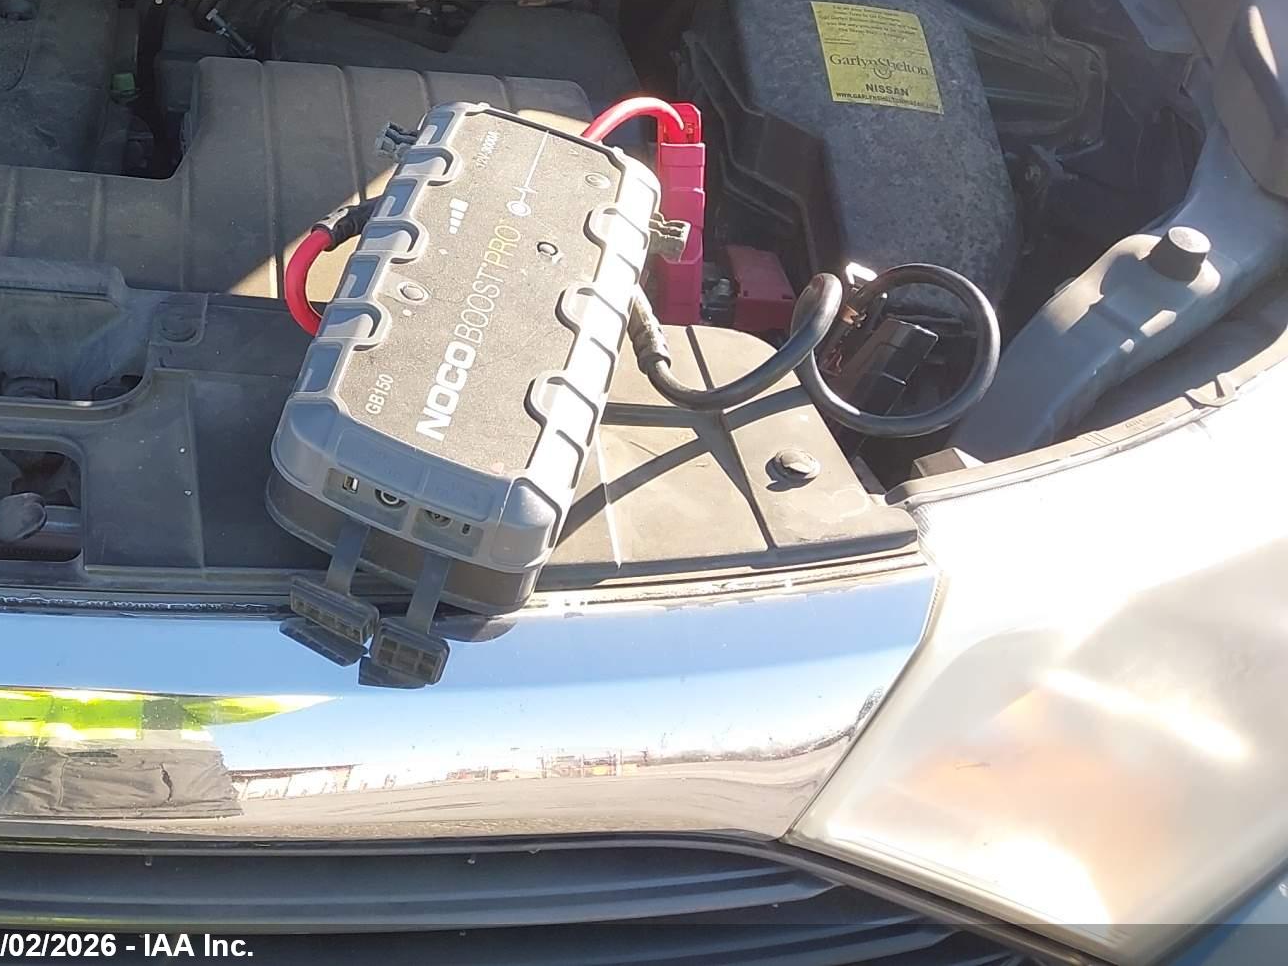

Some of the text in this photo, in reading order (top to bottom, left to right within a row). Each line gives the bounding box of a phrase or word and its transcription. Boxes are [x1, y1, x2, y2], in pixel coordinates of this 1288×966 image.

[865, 82, 910, 97] NISSAN
[365, 374, 394, 414] GB150
[415, 340, 476, 442] NOCO
